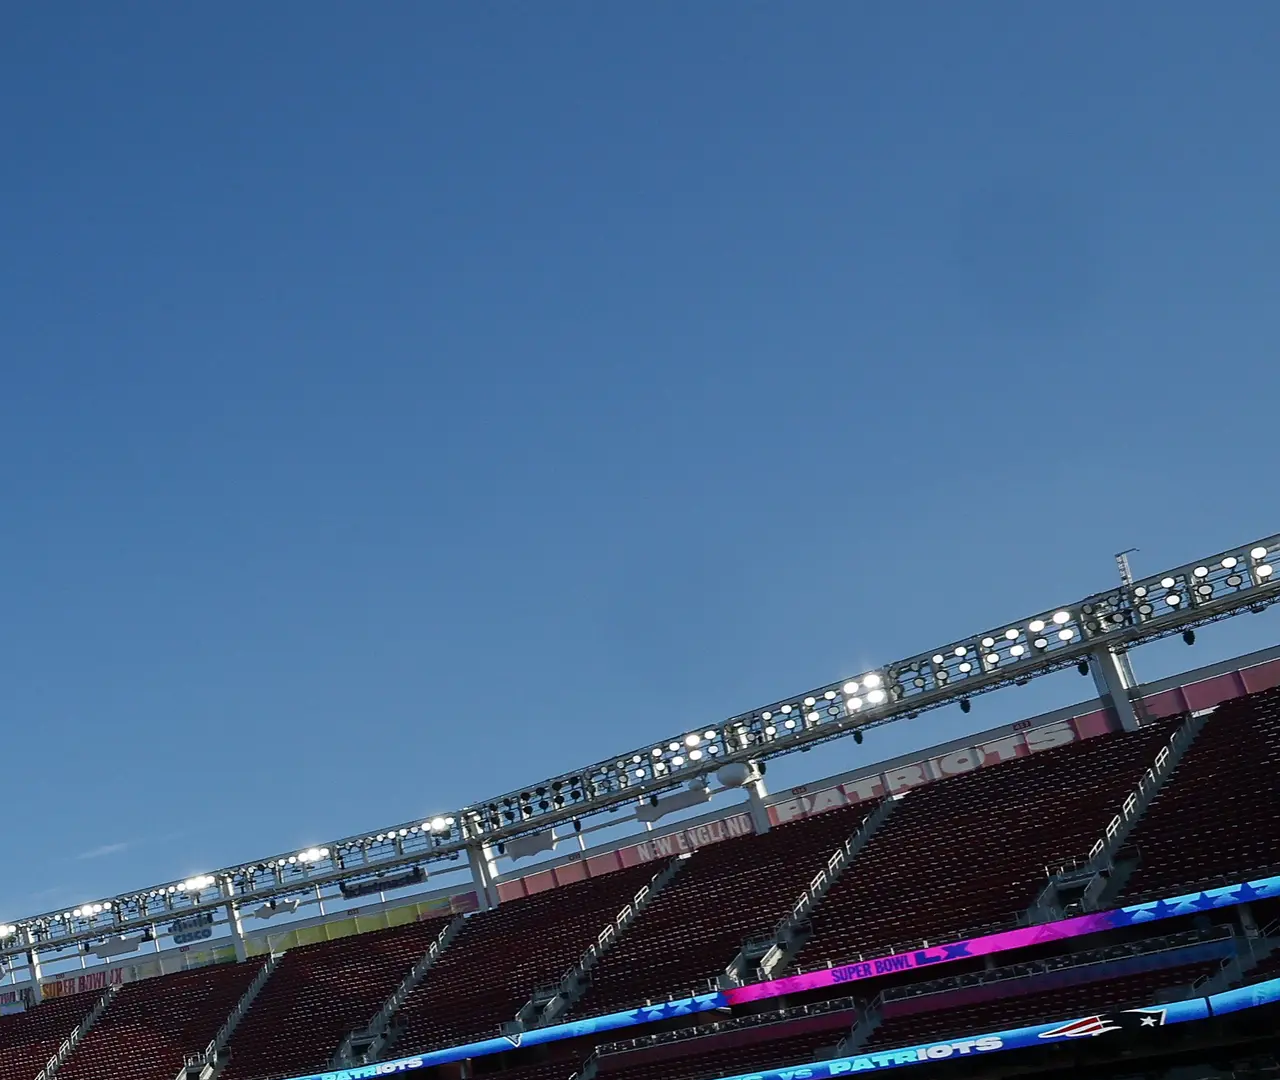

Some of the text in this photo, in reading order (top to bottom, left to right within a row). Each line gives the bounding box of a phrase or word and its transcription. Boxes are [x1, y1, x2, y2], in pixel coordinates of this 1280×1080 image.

[773, 719, 1077, 823] PATRIOTS
[637, 814, 753, 862] NEW ENGLAND
[831, 941, 971, 983] SUPER BOWL LX
[778, 1069, 813, 1080] VS
[829, 1037, 1004, 1076] PATRIOTS
